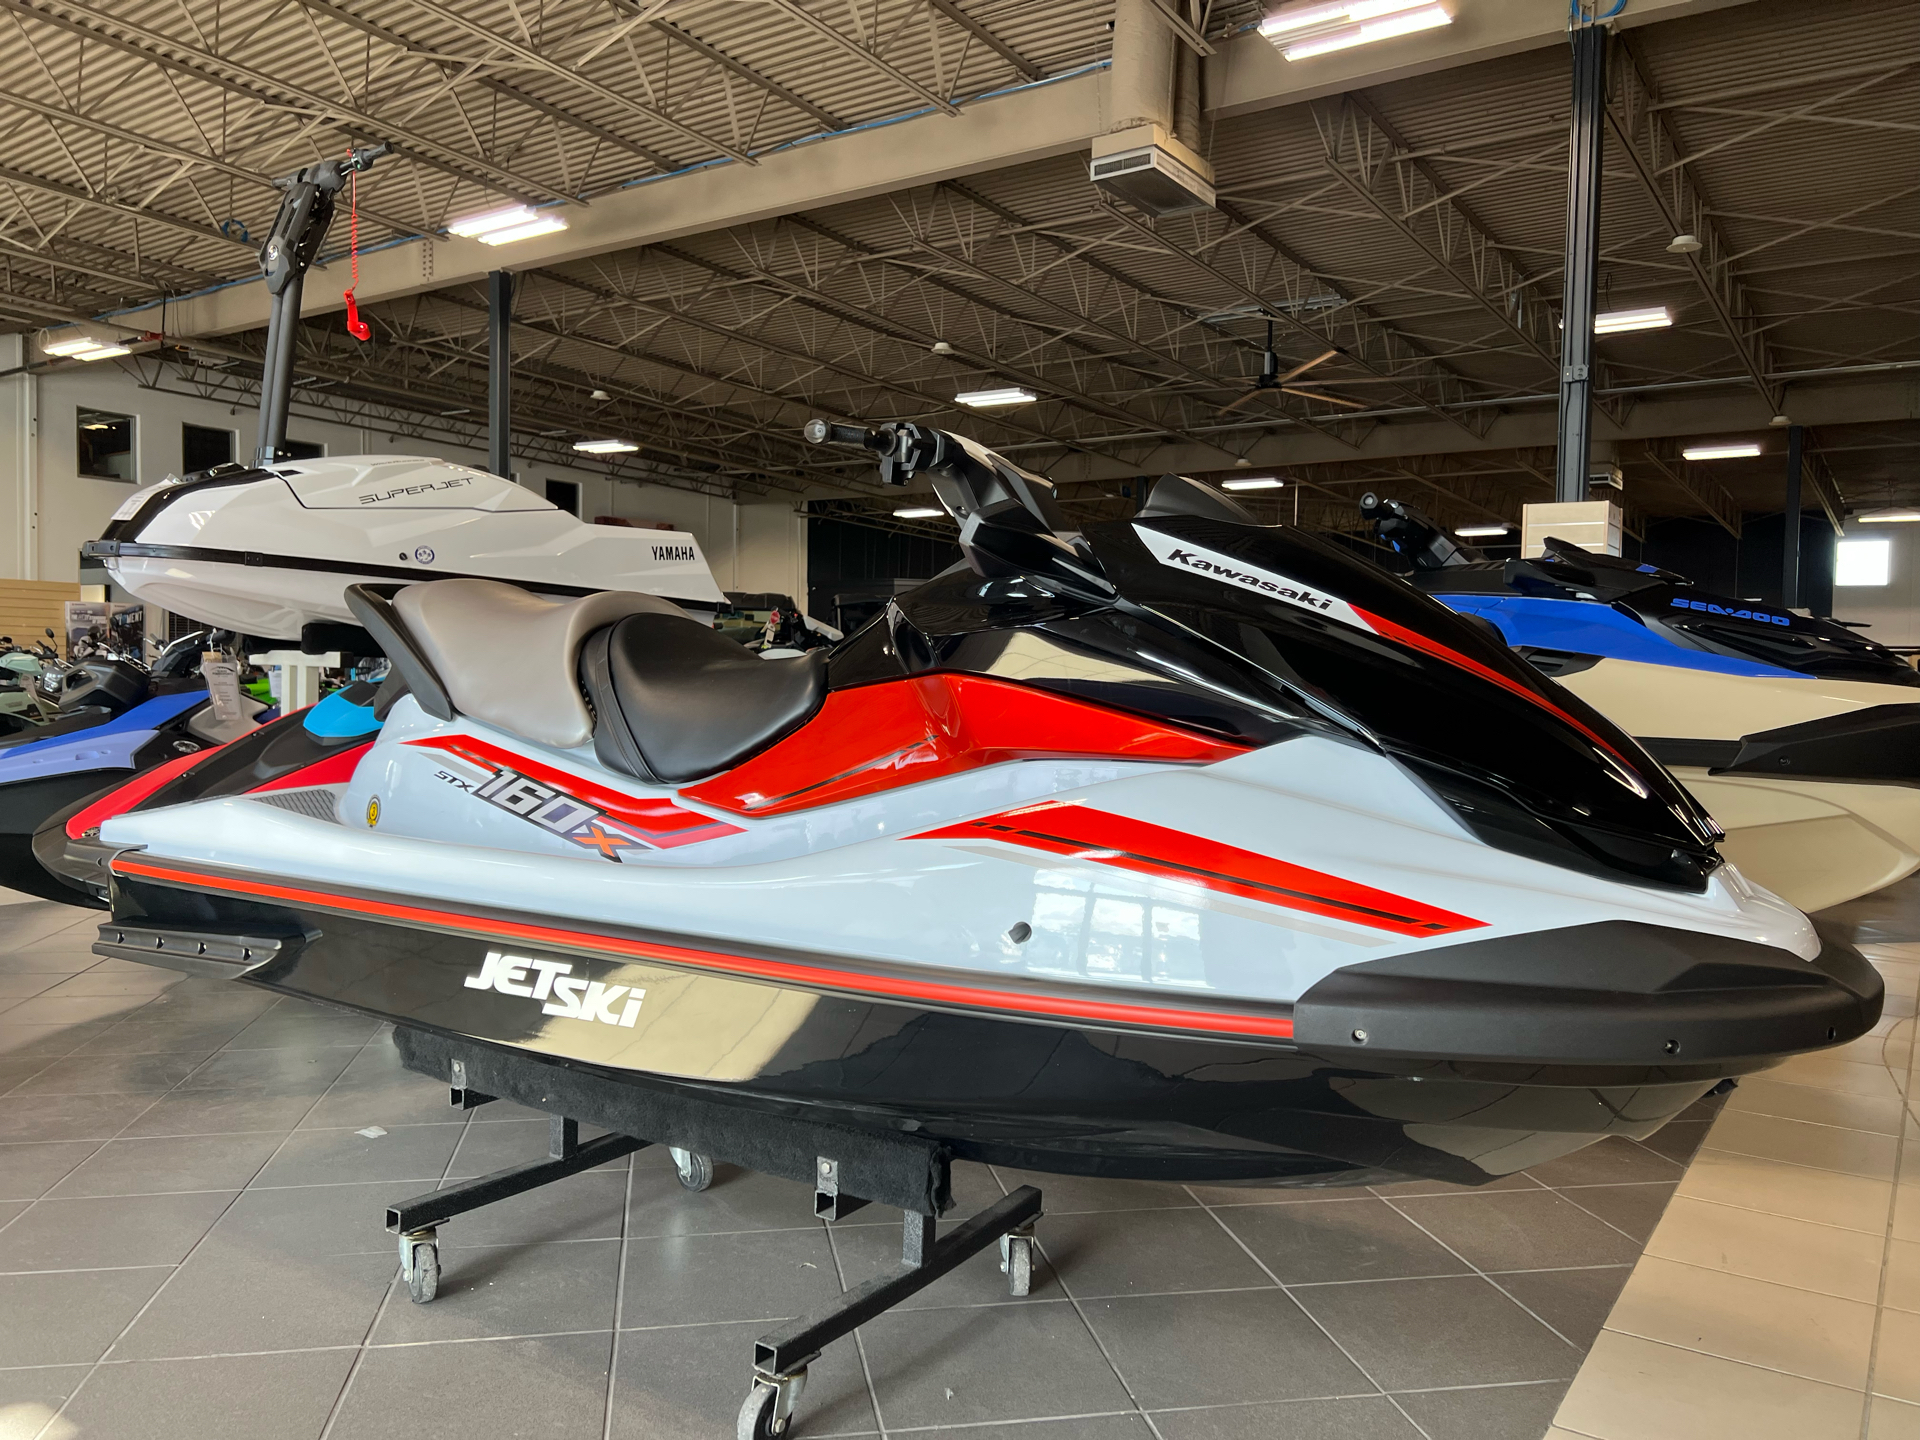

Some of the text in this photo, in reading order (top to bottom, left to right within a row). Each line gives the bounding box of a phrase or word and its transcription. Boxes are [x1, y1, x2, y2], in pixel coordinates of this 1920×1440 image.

[358, 477, 474, 505] SUPERJET
[651, 546, 695, 561] YAMAHA
[1167, 549, 1333, 611] Kawasaki
[434, 770, 474, 793] STX
